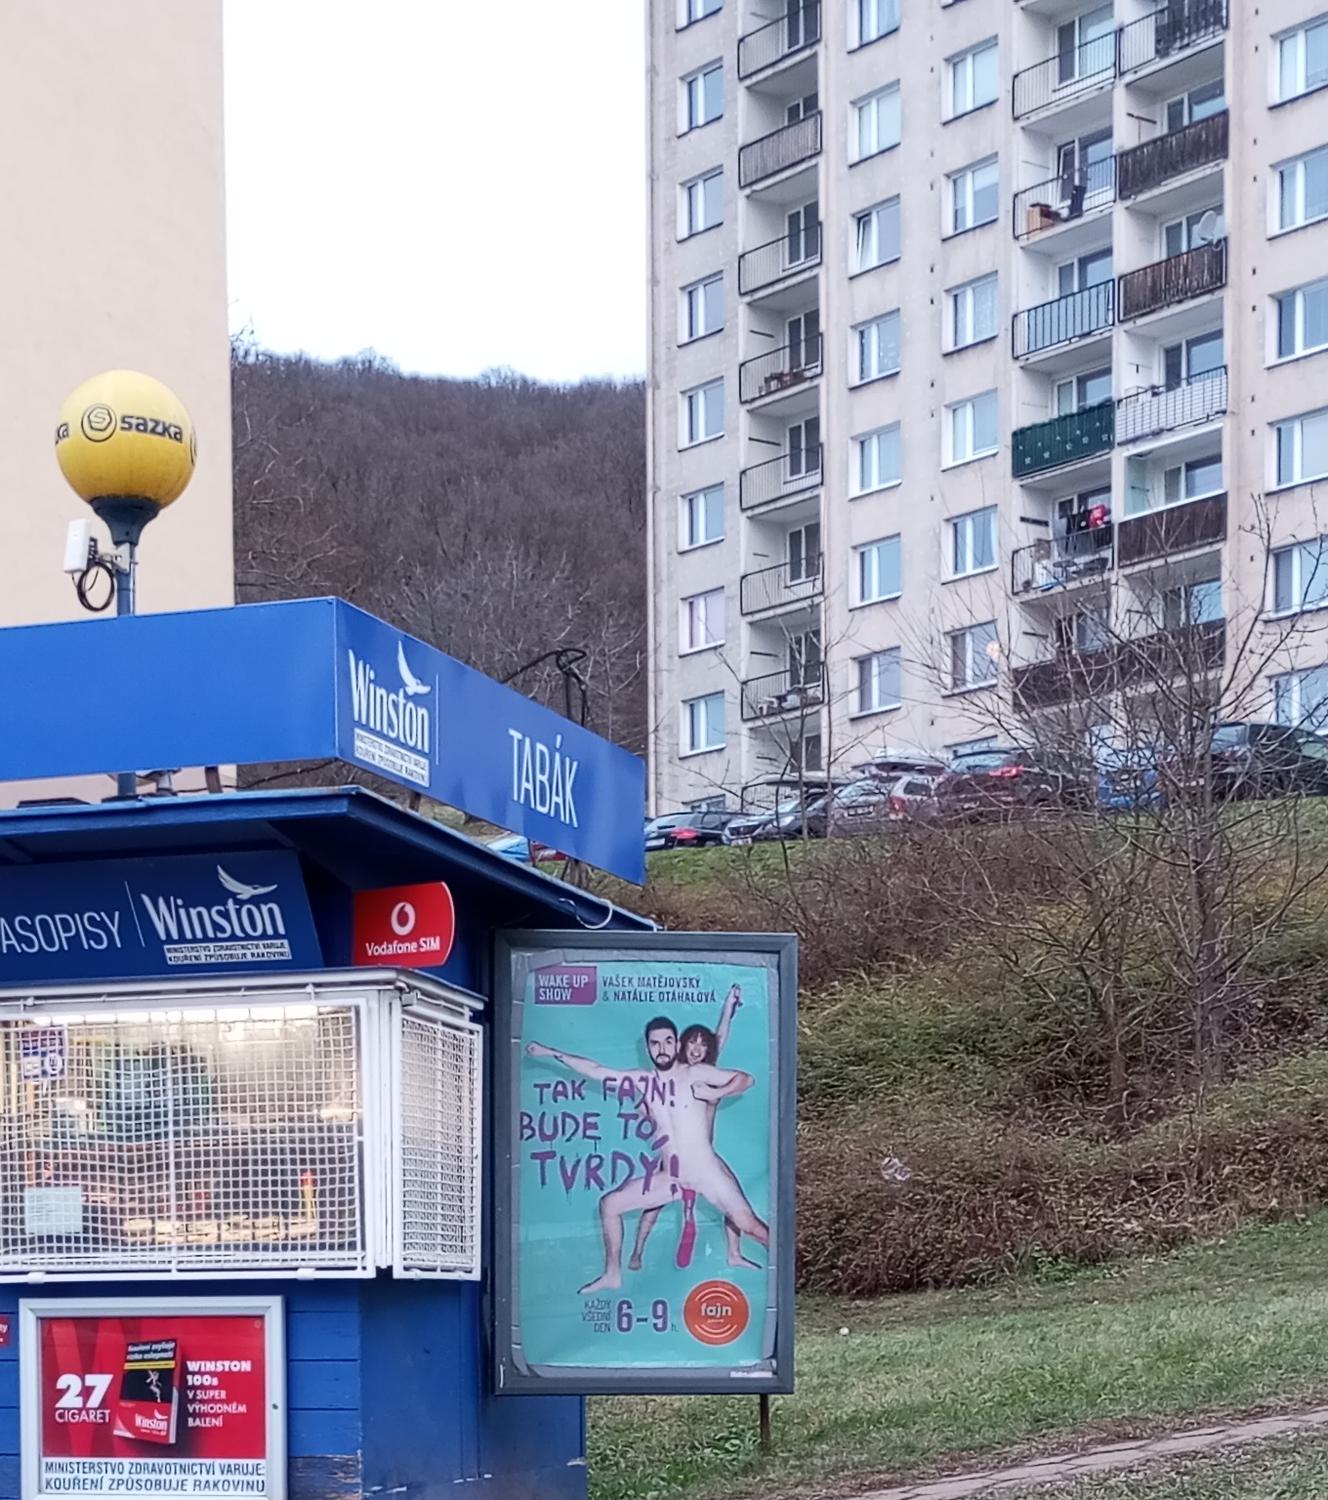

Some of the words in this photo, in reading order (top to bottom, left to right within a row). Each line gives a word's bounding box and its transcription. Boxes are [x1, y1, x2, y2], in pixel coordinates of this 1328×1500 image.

[119, 414, 183, 444] sazka
[348, 648, 430, 754] Winston
[508, 727, 579, 829] TABÁK
[140, 892, 286, 942] Winston
[365, 939, 418, 957] Vodafone
[419, 935, 440, 953] SIM
[538, 974, 570, 988] WAKE
[573, 975, 589, 988] UP
[602, 974, 634, 988] VAŠEK
[637, 973, 701, 989] MATĚJOVSKÝ
[538, 987, 572, 1001] SHOW
[613, 988, 655, 1002] NATÁLIE
[658, 988, 717, 1003] OTÁHALOVÁ
[533, 1078, 587, 1106] TAK
[602, 1073, 676, 1111] FAJN!
[520, 1110, 603, 1145] BUDE
[582, 1310, 612, 1322] VŠEDNÍ
[700, 1302, 732, 1318] fajn
[594, 1322, 611, 1333] DEN
[186, 1360, 252, 1373] WINSTON
[186, 1374, 219, 1387] 100s
[54, 1373, 114, 1409] 27
[186, 1389, 196, 1400] V
[197, 1389, 227, 1400] SUPER
[186, 1401, 248, 1414] VÝHODNÉM
[54, 1408, 111, 1424] CIGARET
[134, 1412, 168, 1432] Winston
[186, 1414, 224, 1428] BALENÍ
[44, 1461, 125, 1475] MINISTERSTVO
[128, 1460, 216, 1477] ZDRAVOTNICTVÍ
[219, 1462, 266, 1477] VARUJE:
[44, 1476, 104, 1491] KOUŘENÍ
[107, 1476, 189, 1492] ZPŮSOBUJE
[192, 1478, 266, 1493] RAKOVINU
